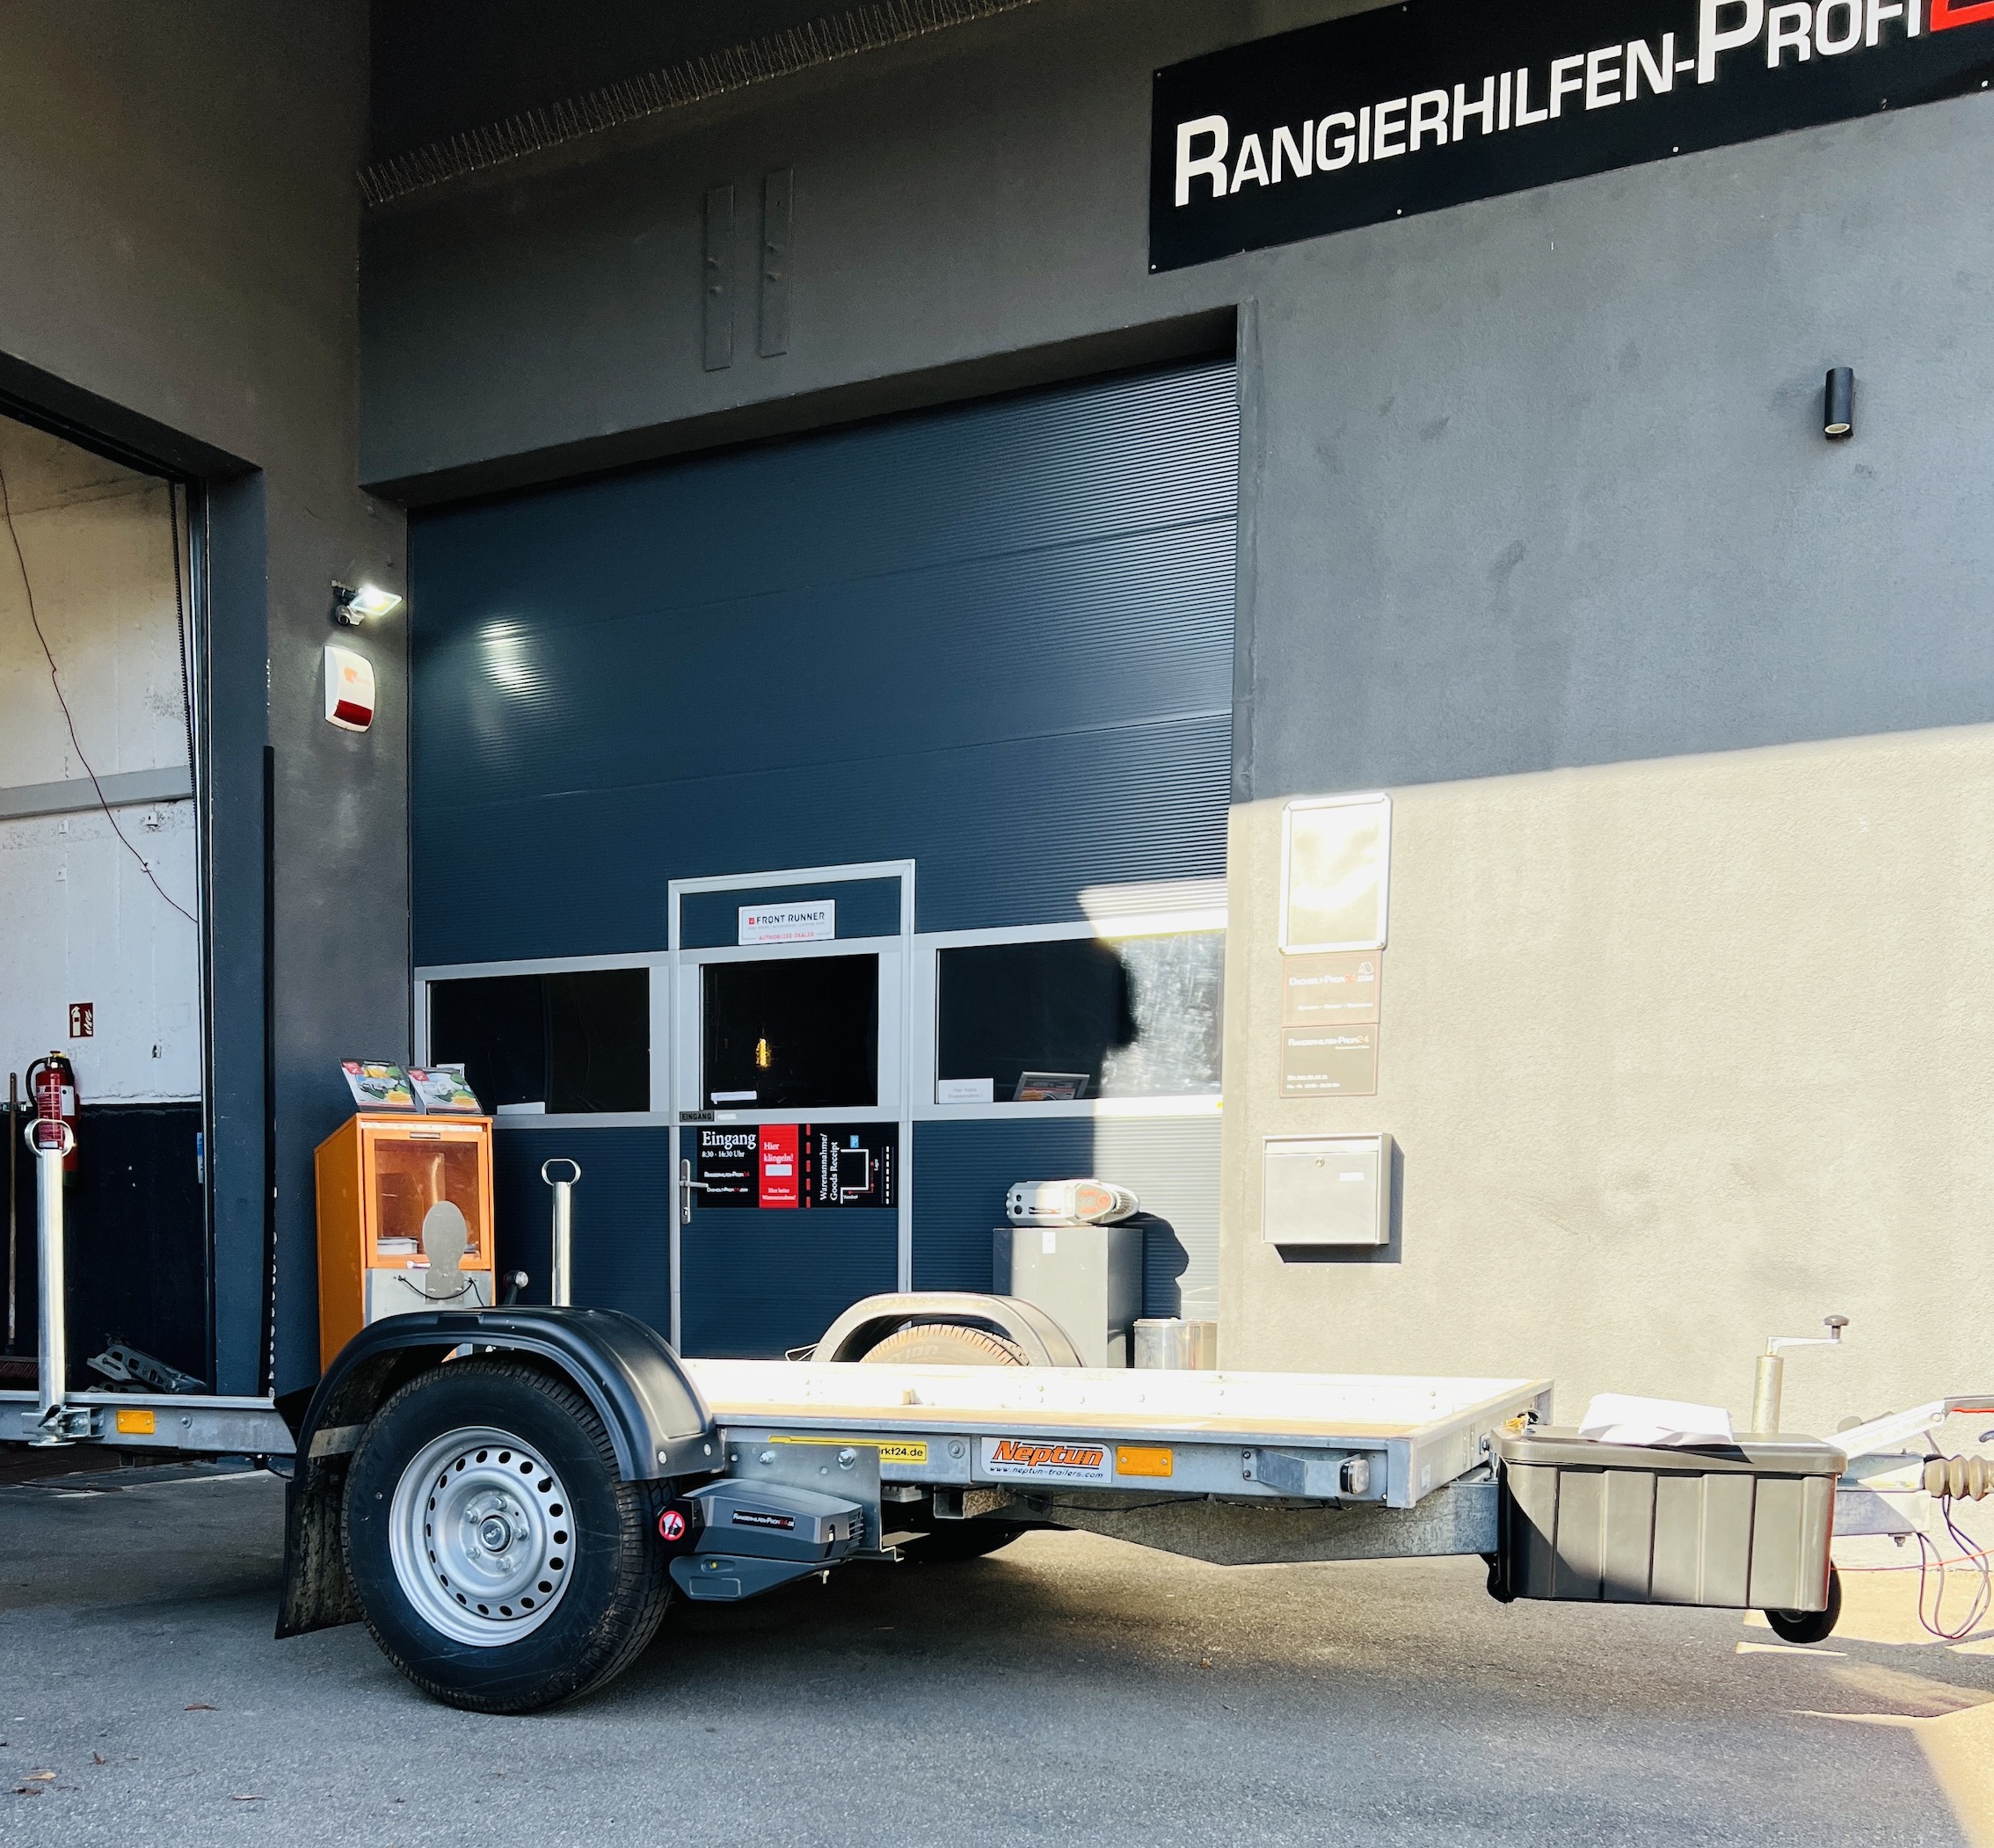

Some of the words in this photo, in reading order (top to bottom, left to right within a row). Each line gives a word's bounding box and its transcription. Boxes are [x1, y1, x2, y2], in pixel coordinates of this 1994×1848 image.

[756, 914, 786, 925] FRONT
[788, 912, 825, 922] RUNNER
[702, 1131, 756, 1150] Eingang
[763, 1141, 780, 1151] Hier
[733, 1149, 746, 1158] Uhr
[763, 1153, 794, 1164] klingeln!
[830, 1141, 840, 1172] Receipt
[819, 1132, 828, 1201] Warenannahme/
[881, 1447, 924, 1457] rkt24.de
[991, 1440, 1103, 1467] Neptun
[989, 1466, 1103, 1479] www.neptun-trailers.com
